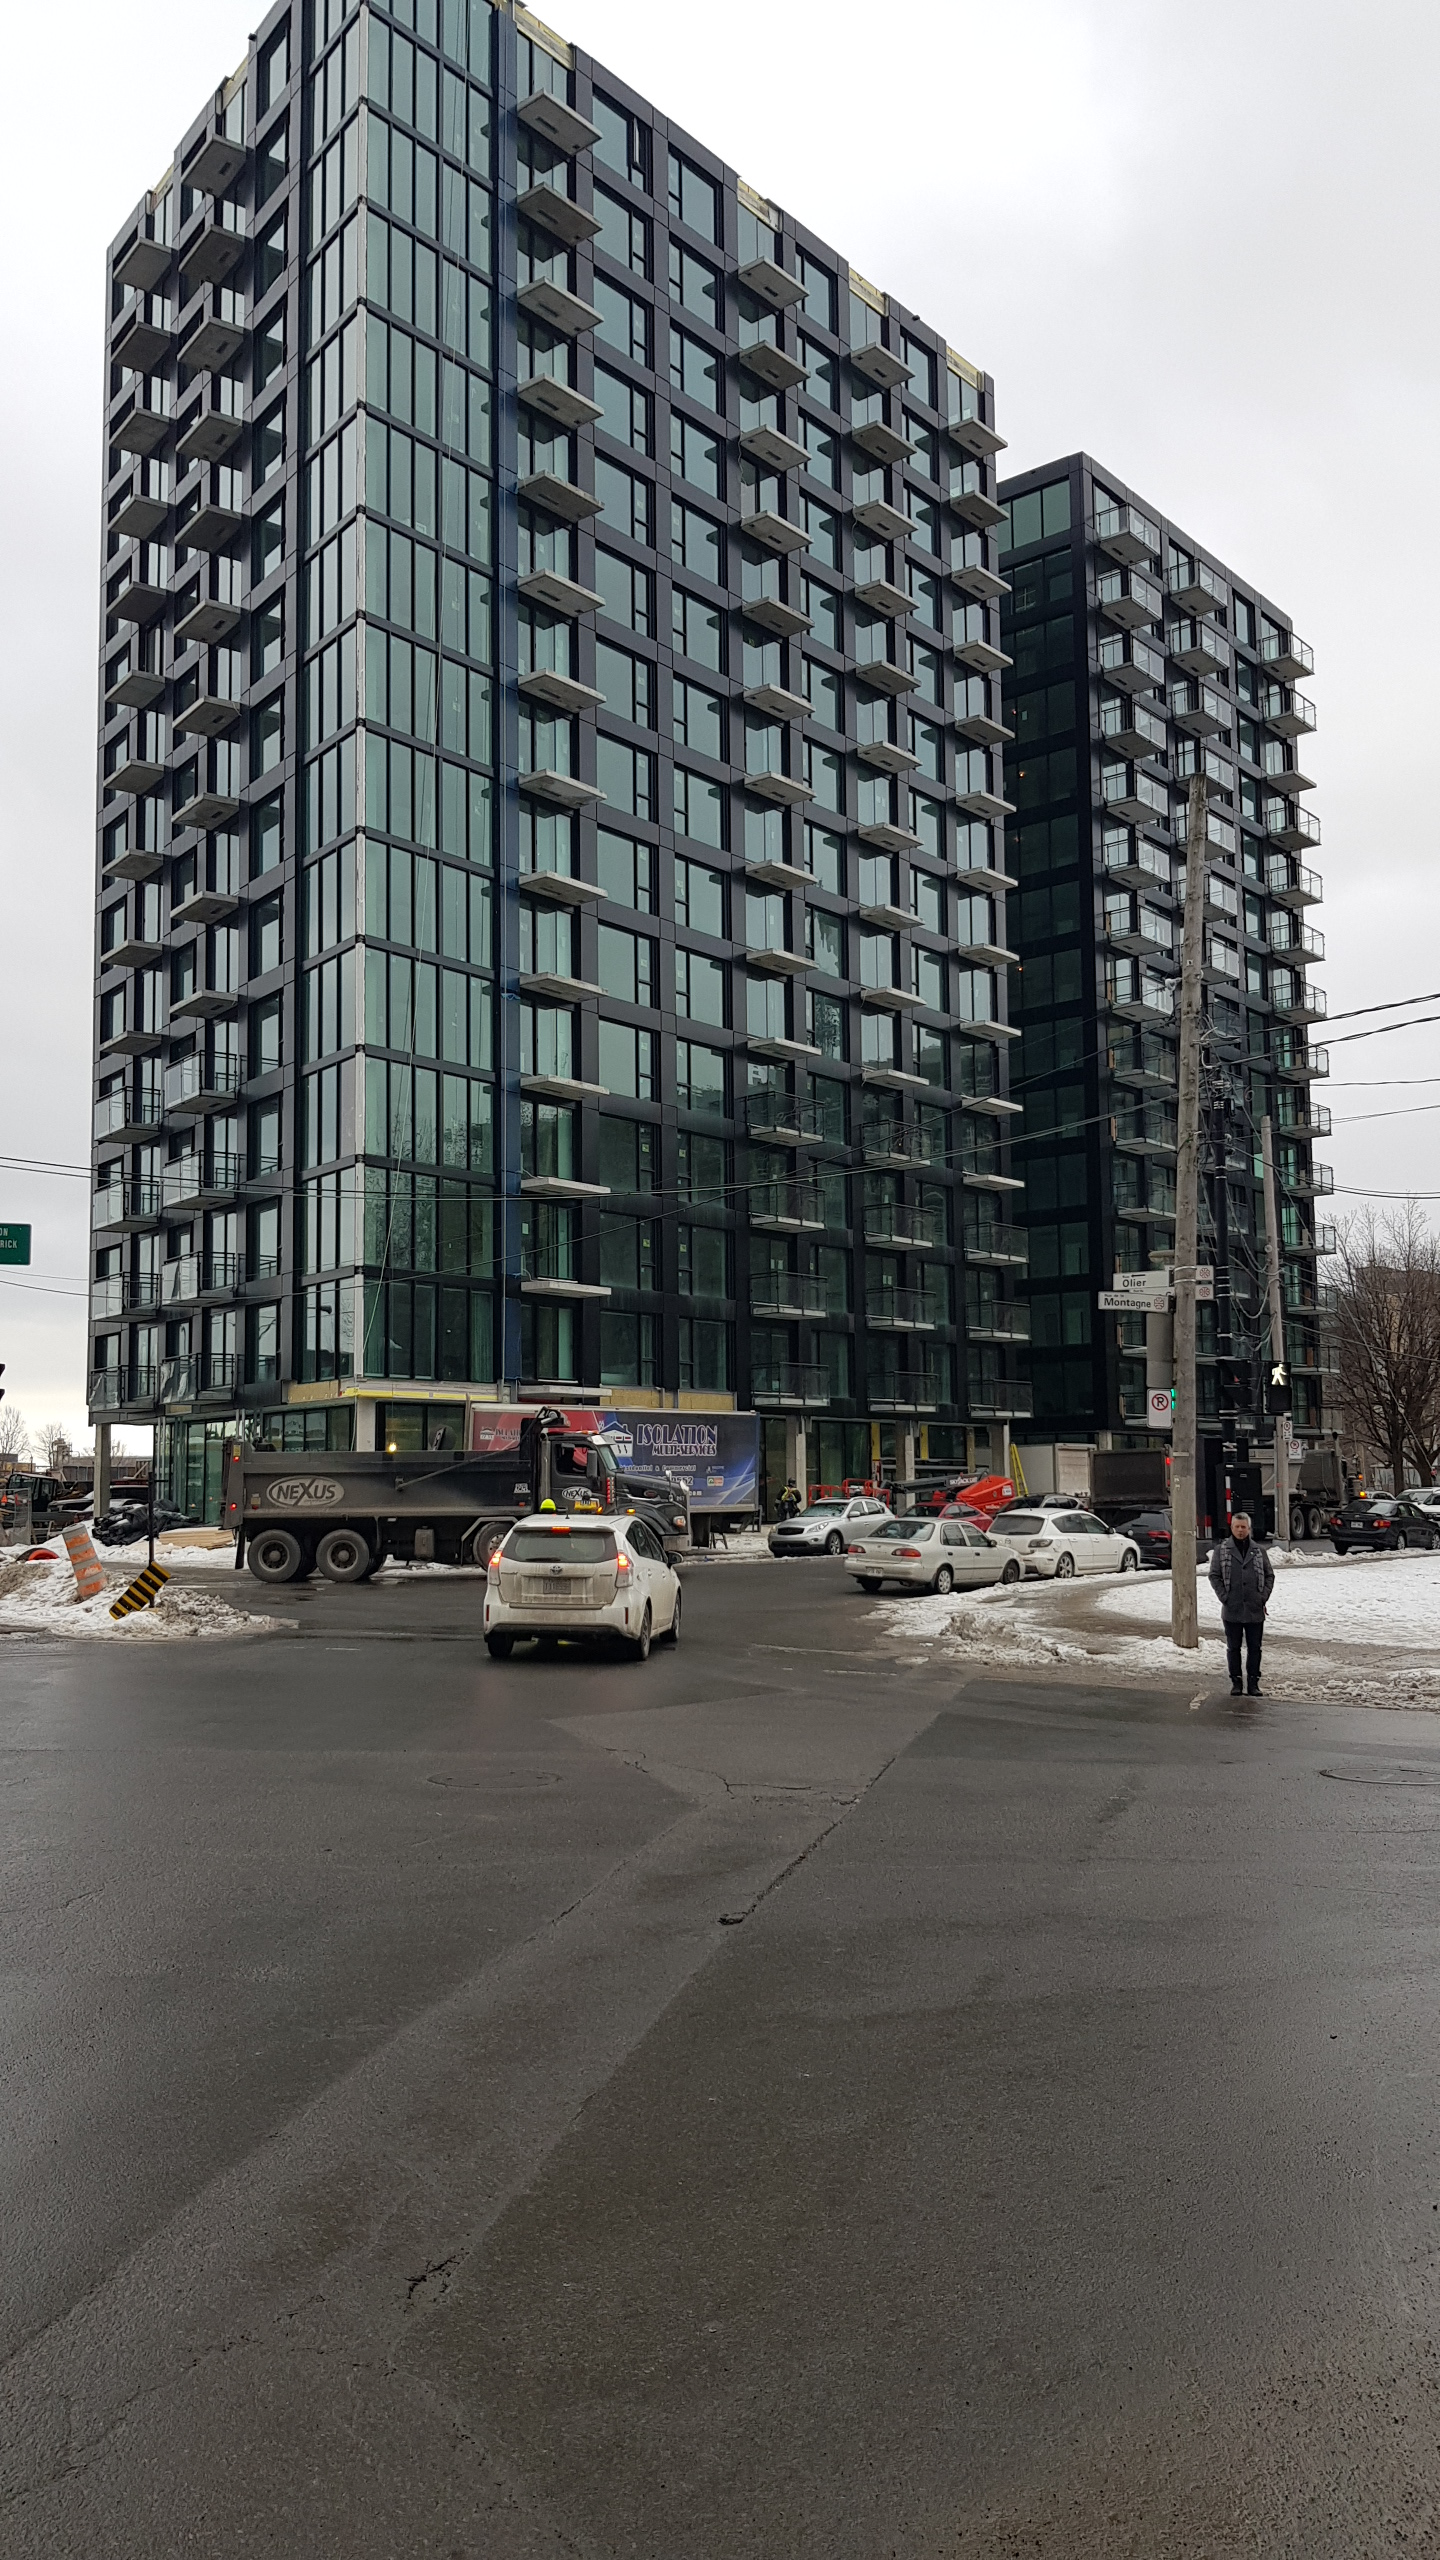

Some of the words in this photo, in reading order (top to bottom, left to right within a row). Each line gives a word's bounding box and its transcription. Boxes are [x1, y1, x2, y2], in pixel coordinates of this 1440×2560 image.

[1122, 1279, 1147, 1288] Olier
[1104, 1297, 1152, 1309] Montagne
[637, 1424, 718, 1446] ISOLATION
[652, 1444, 717, 1457] MULTI-SERVICES
[277, 1478, 337, 1507] NEXUS
